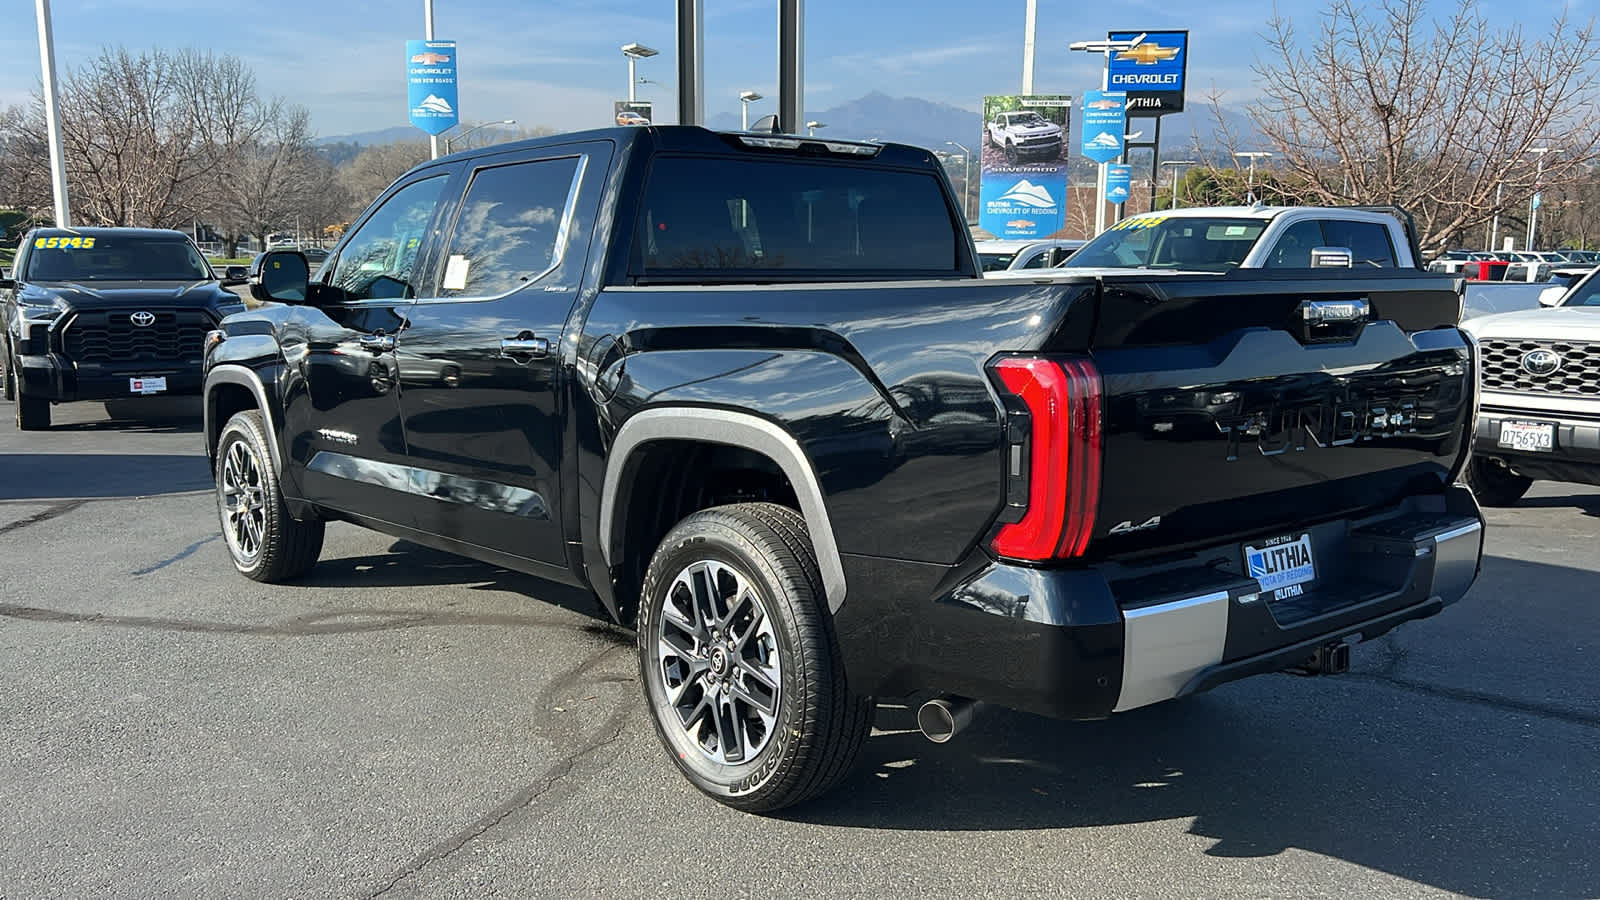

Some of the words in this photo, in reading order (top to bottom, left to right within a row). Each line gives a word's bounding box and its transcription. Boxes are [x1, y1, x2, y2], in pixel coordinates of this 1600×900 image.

[1112, 74, 1178, 84] CHEVROLET
[1502, 430, 1550, 447] 07565X3
[1265, 537, 1280, 547] SINCE
[1262, 543, 1311, 574] LITHIA
[1280, 583, 1304, 598] LITHIA
